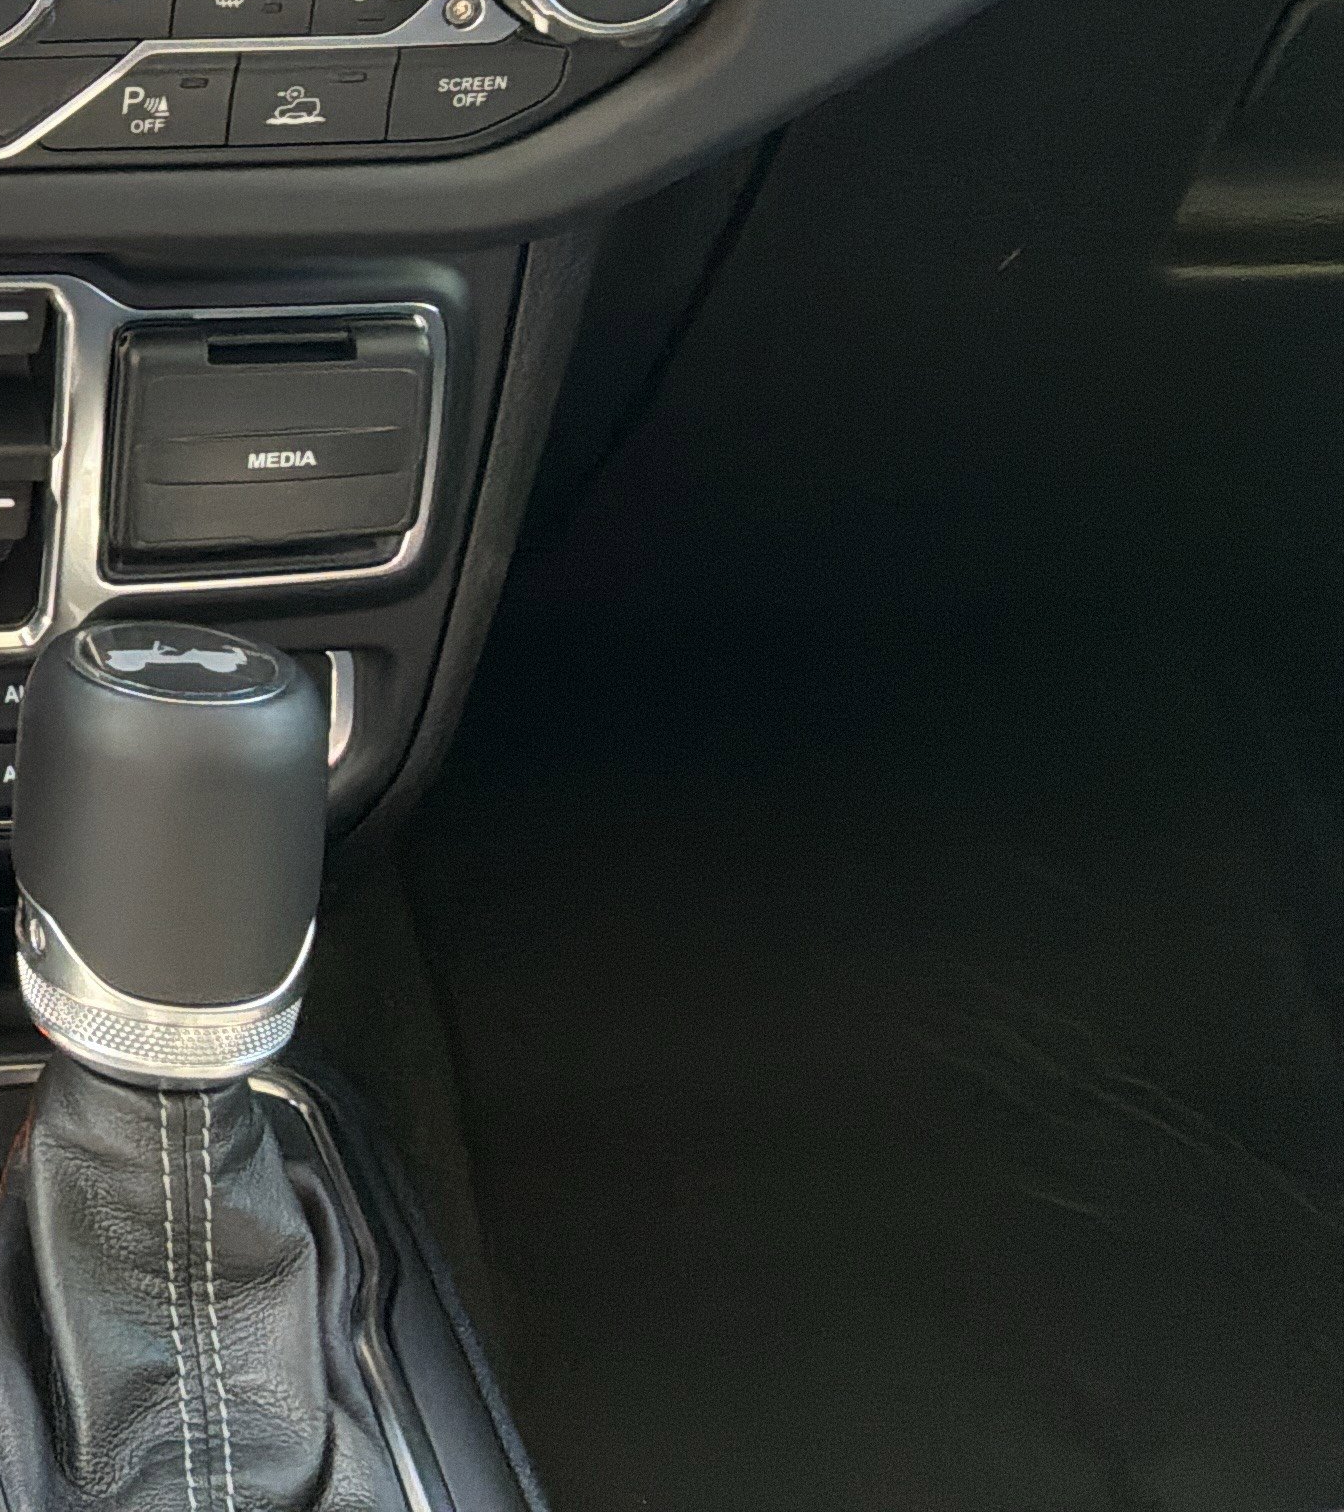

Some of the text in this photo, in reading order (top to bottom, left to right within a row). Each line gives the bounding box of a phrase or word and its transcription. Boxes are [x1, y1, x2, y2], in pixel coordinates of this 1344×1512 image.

[437, 74, 508, 93] SCREEN
[122, 86, 145, 115] P
[452, 91, 487, 108] OFF
[130, 119, 166, 134] OFF
[247, 450, 318, 469] MEDIA
